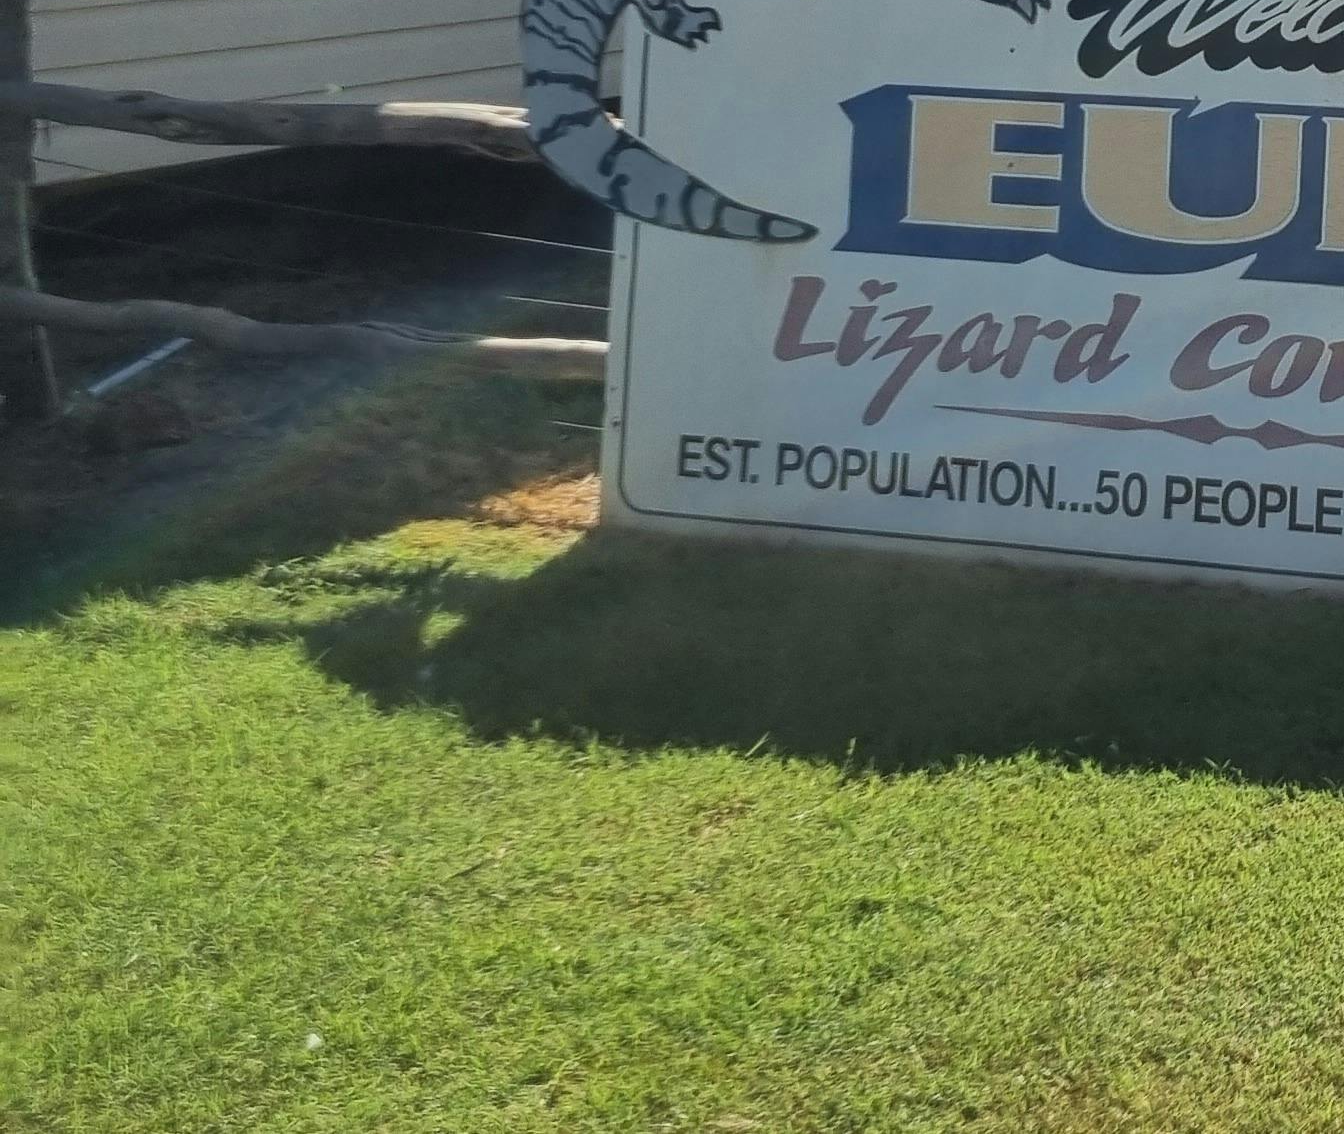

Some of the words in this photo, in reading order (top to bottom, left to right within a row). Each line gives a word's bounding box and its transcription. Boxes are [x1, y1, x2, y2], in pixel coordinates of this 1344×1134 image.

[773, 275, 1142, 426] Lizard
[677, 434, 760, 485] EST.
[1163, 475, 1344, 535] PEOPLE
